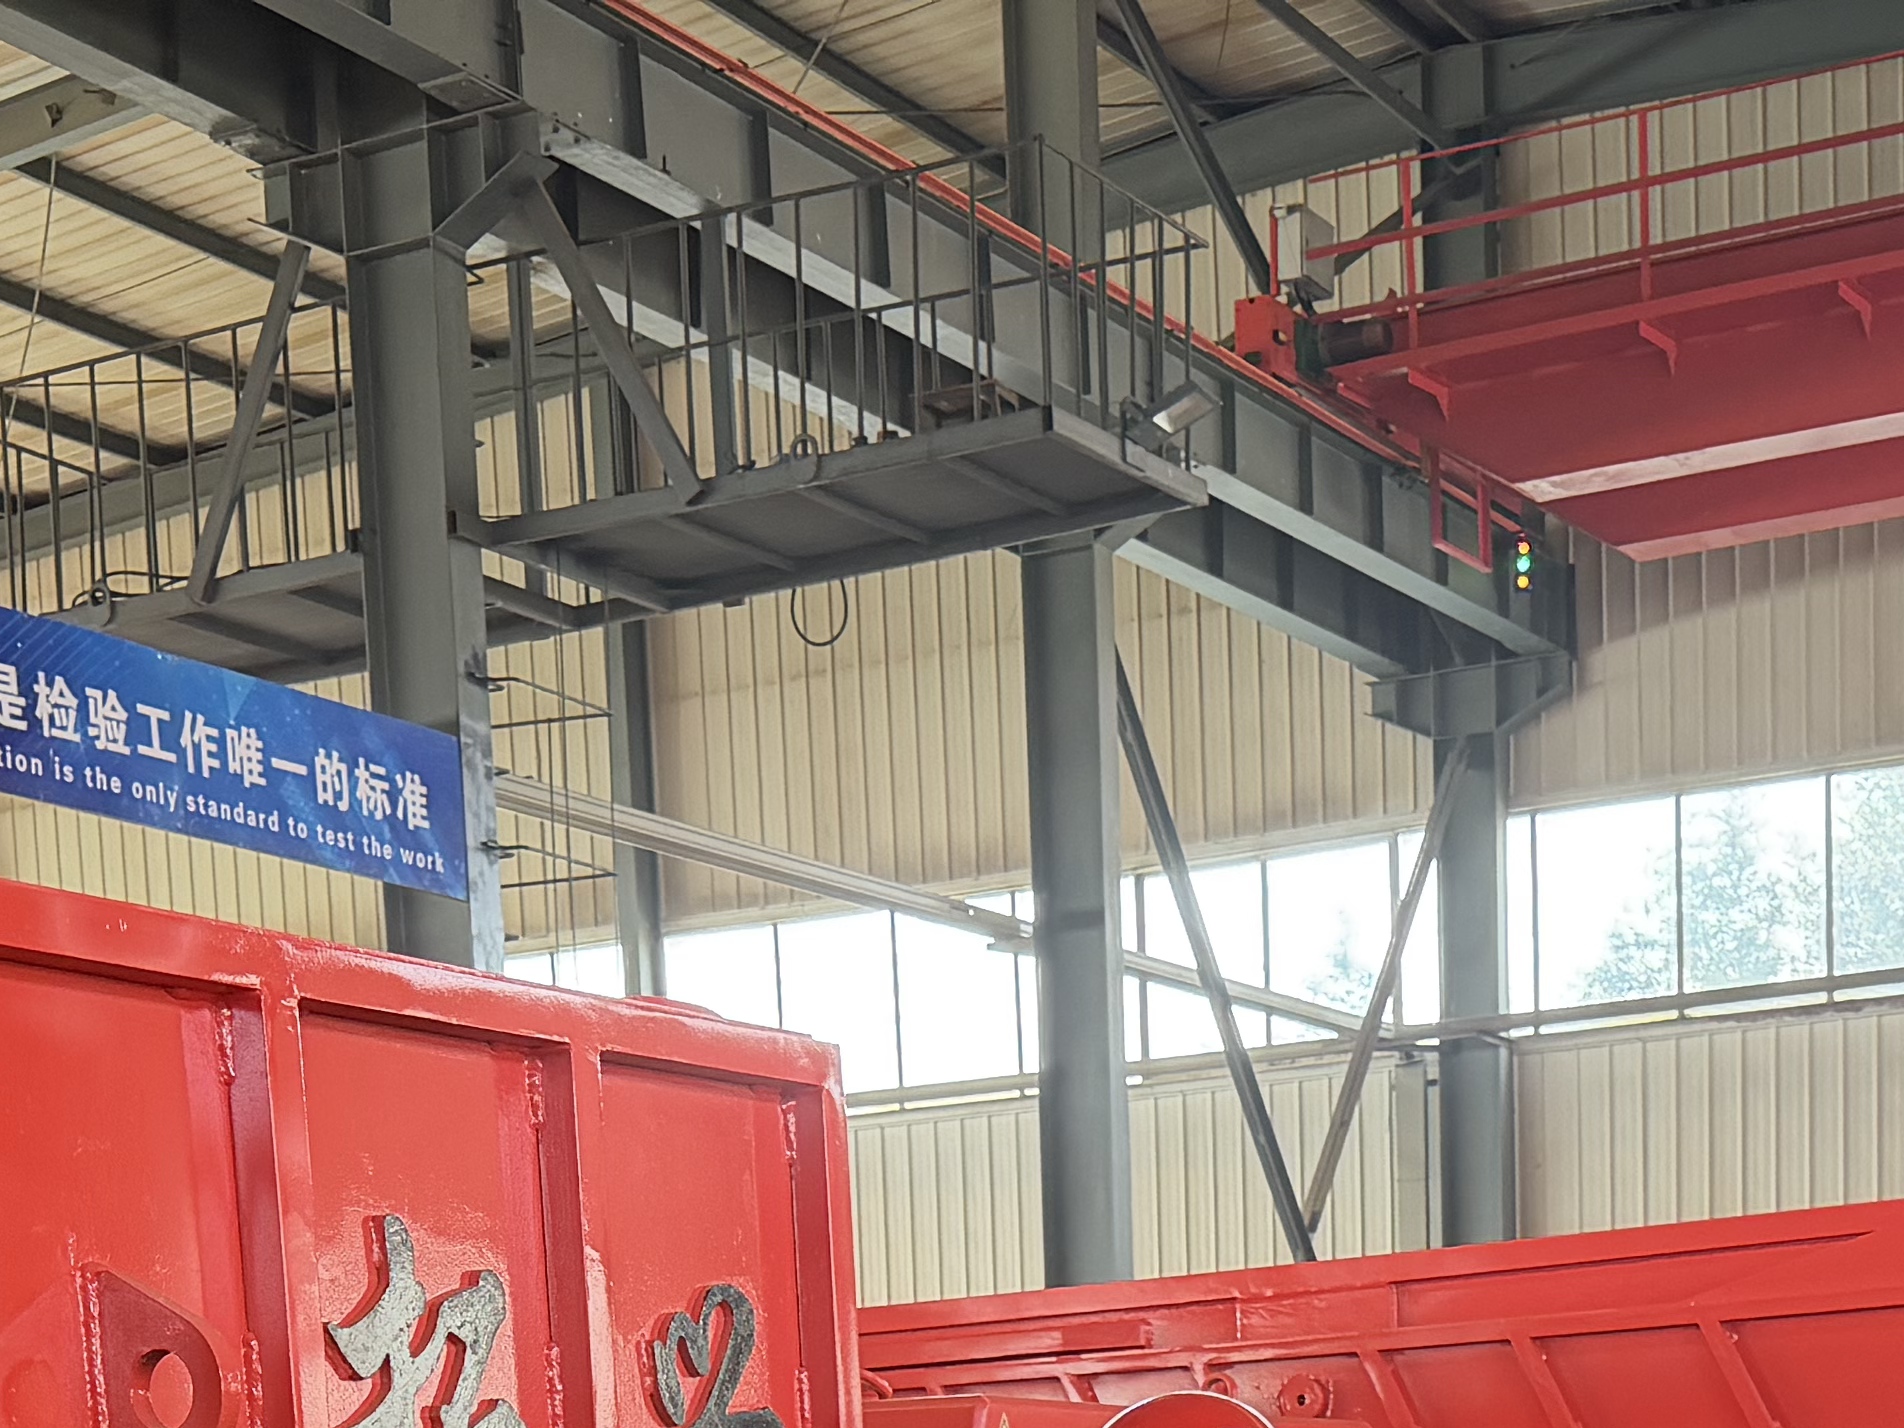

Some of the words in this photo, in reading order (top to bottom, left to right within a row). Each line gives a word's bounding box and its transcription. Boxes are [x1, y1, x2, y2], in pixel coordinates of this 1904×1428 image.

[54, 758, 75, 783] is
[84, 767, 122, 794] the
[132, 781, 178, 812] only
[186, 794, 280, 833] standard
[287, 816, 308, 840] to
[316, 824, 356, 851] test
[362, 836, 393, 860] the
[400, 846, 445, 874] work
